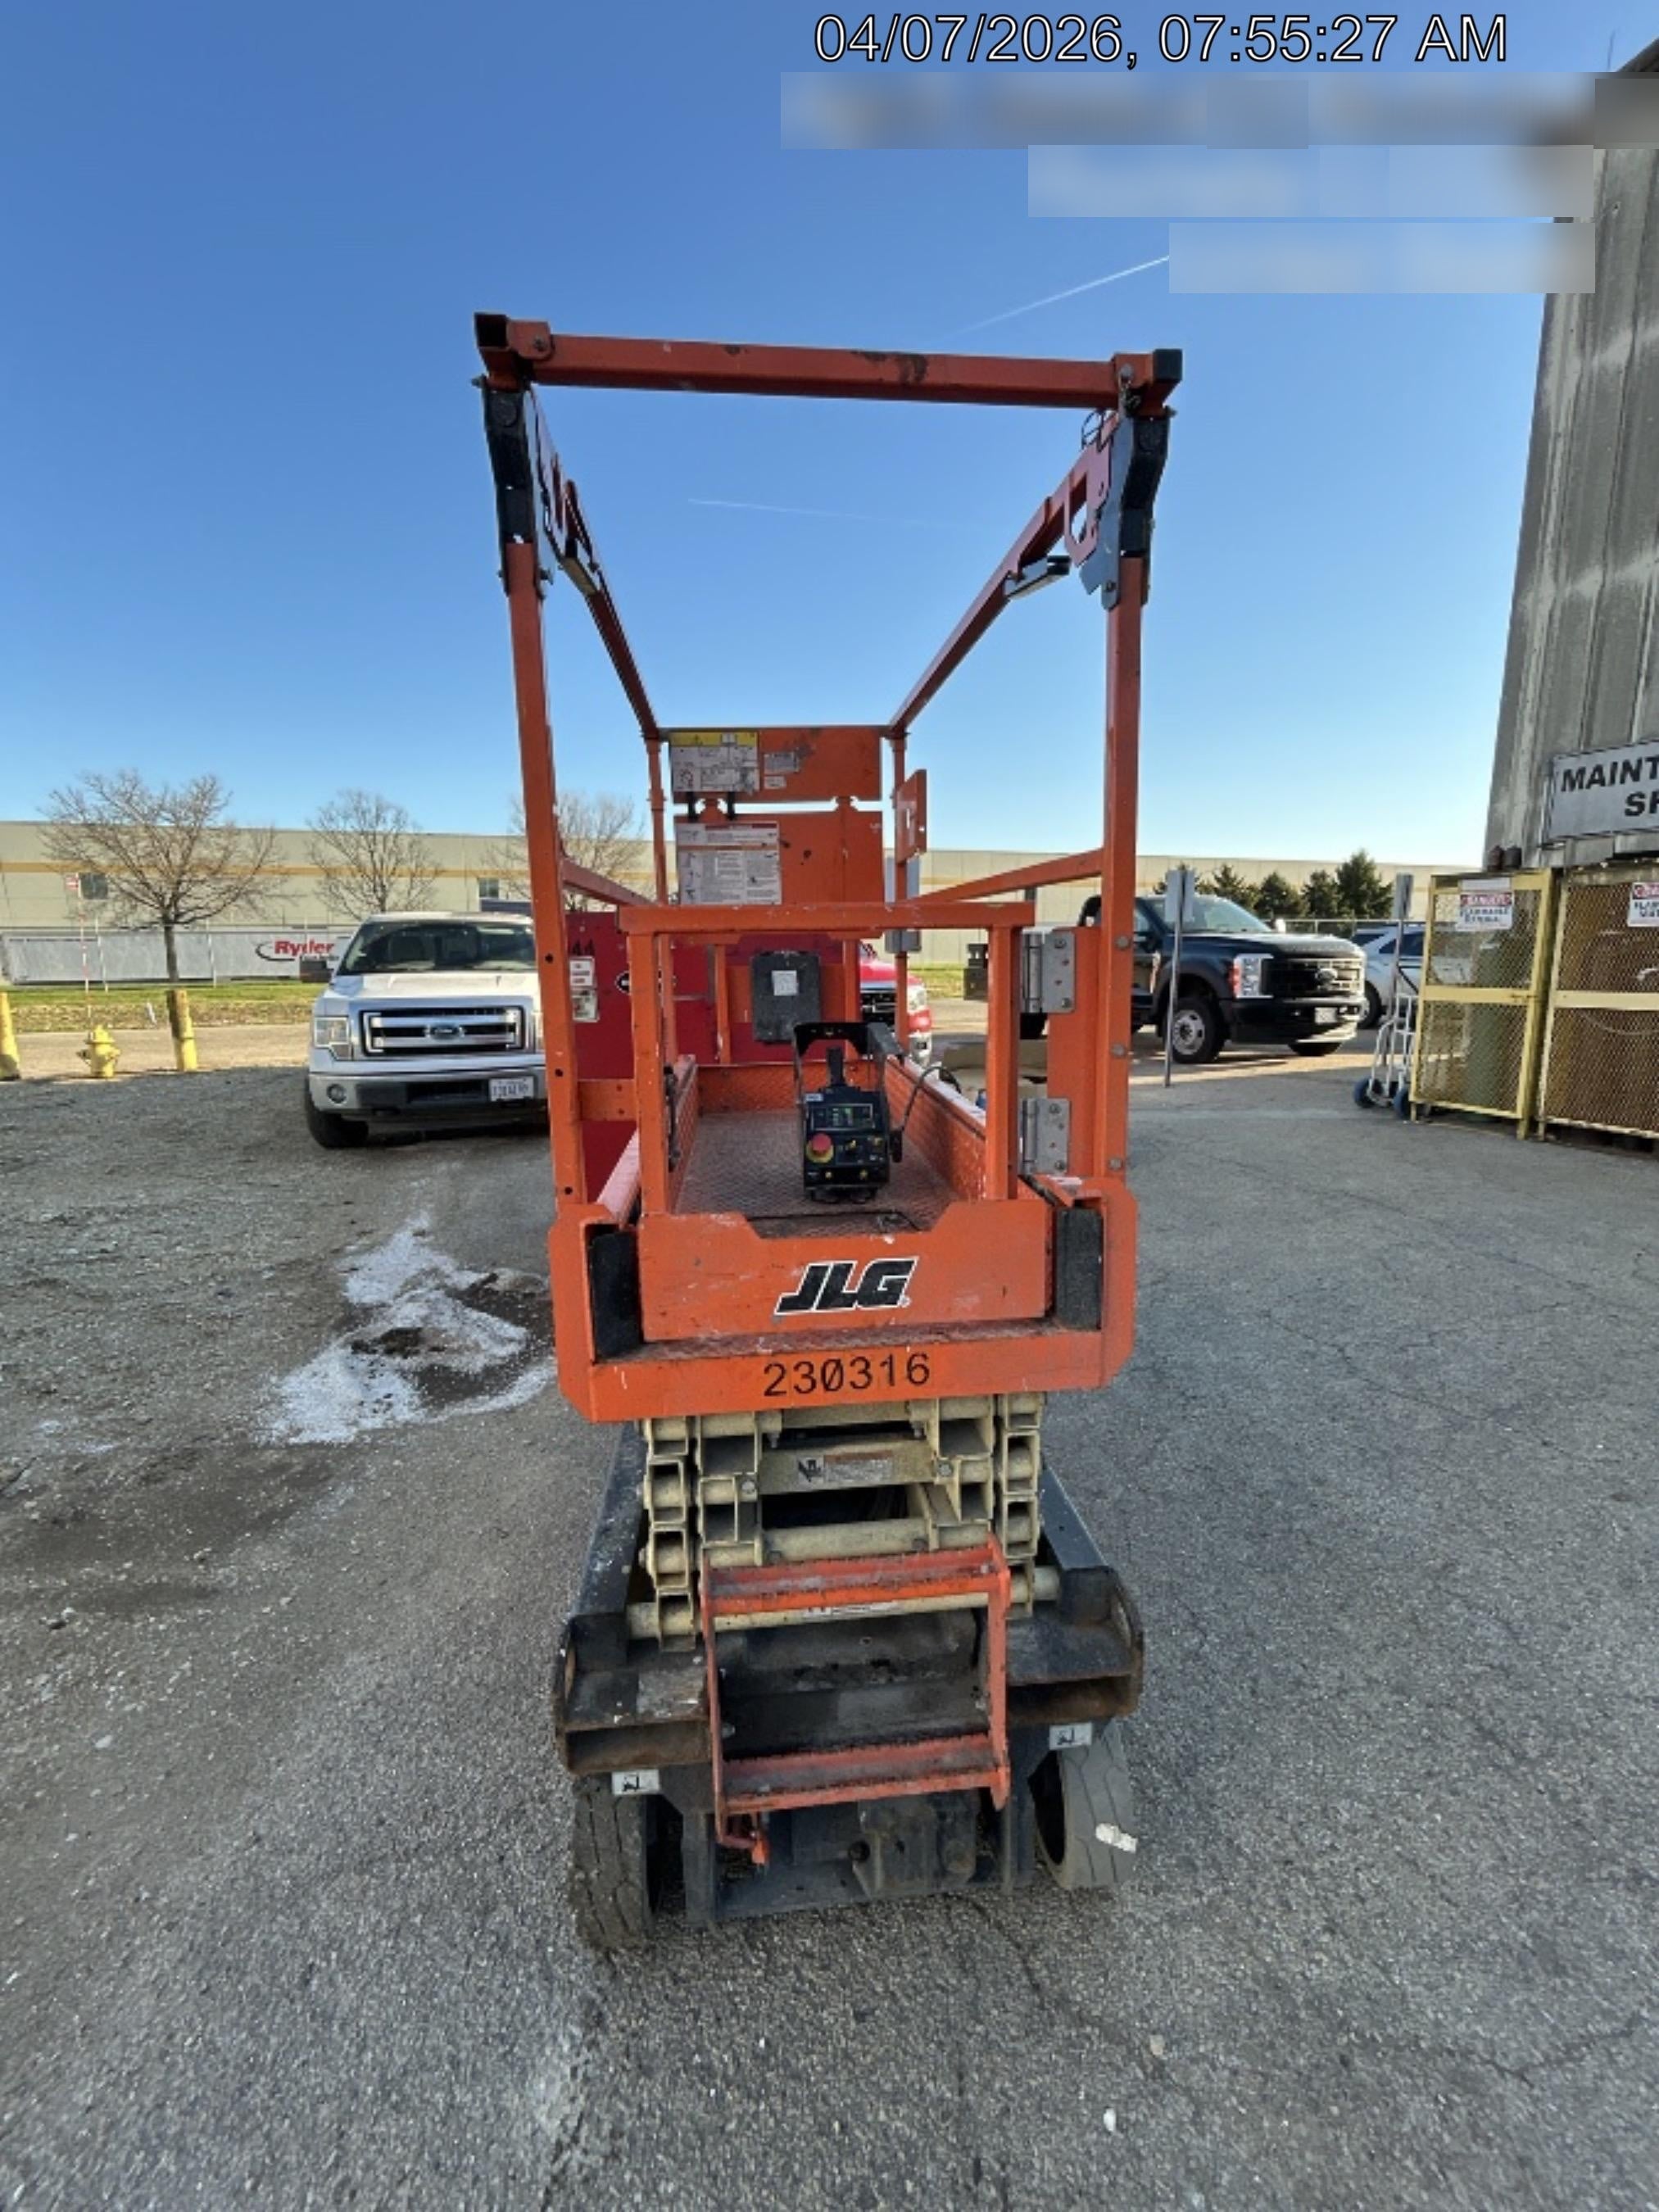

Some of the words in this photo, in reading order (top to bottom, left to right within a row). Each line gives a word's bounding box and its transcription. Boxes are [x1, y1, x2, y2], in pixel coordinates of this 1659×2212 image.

[1561, 755, 1659, 792] MAINT
[274, 939, 335, 957] Ryder
[773, 1256, 919, 1317] JLG
[763, 1353, 930, 1397] 230316
